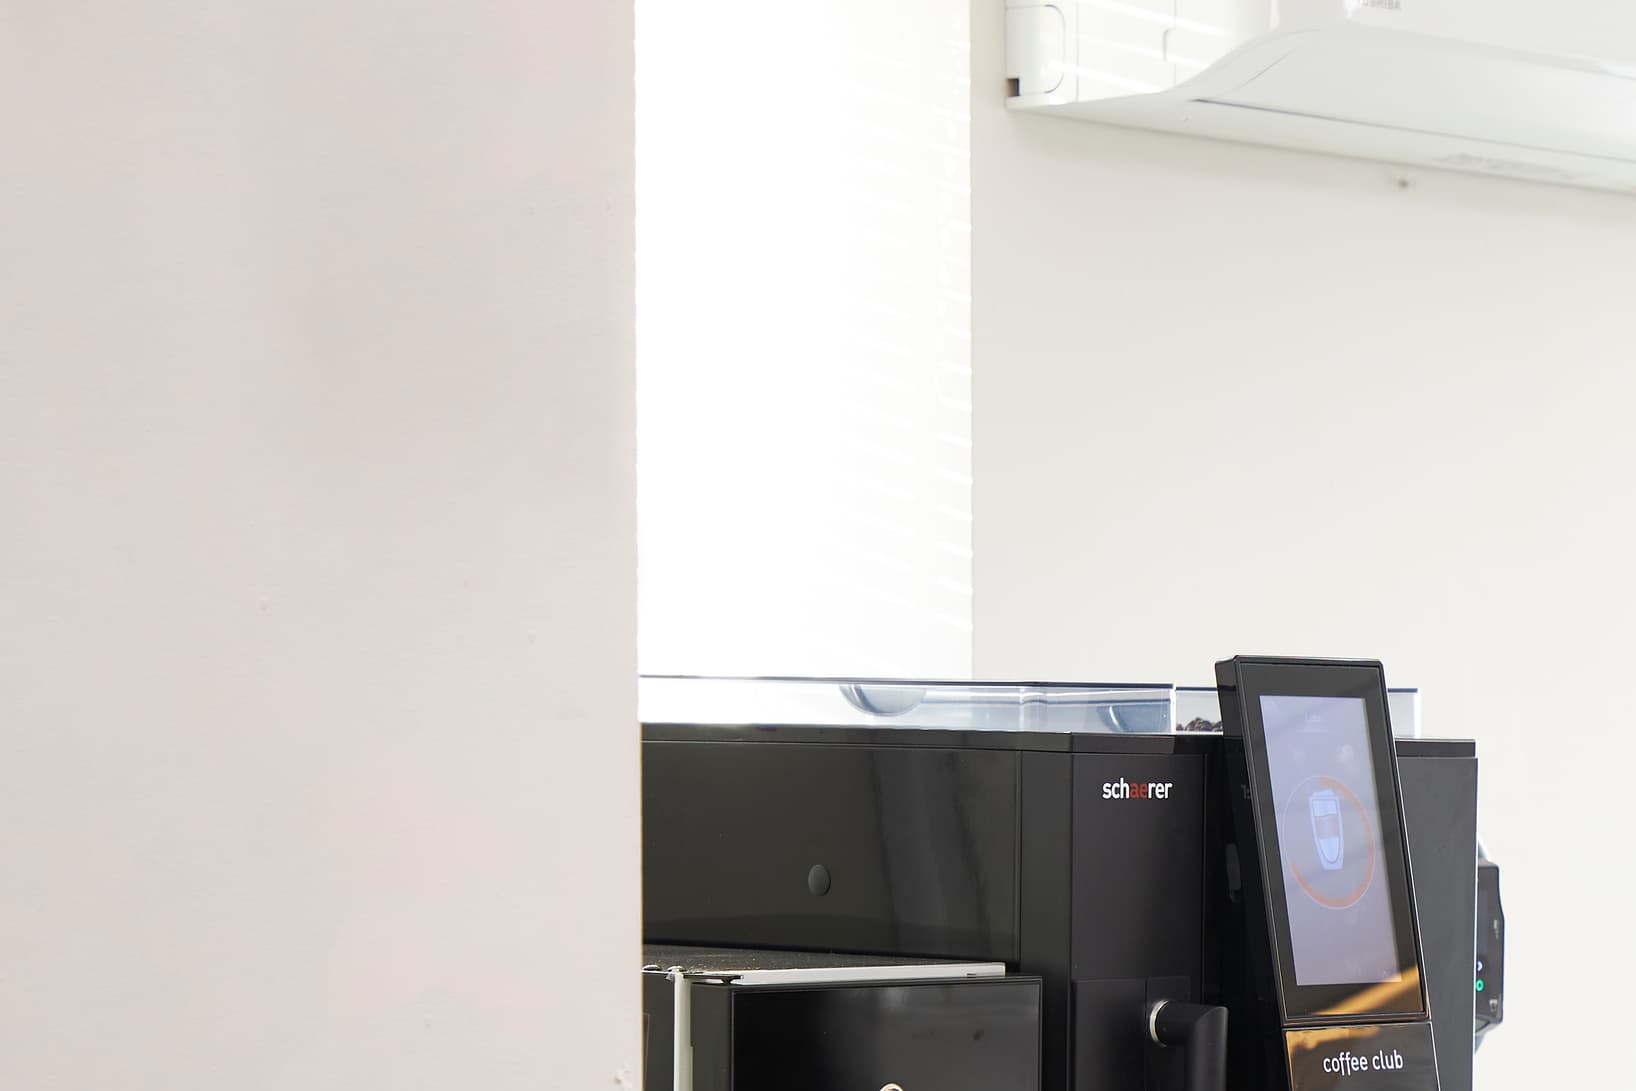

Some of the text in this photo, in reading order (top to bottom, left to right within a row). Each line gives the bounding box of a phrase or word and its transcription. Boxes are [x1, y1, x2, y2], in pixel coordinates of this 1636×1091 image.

[1102, 777, 1172, 799] schaerer
[1323, 1049, 1403, 1075] coffee club
